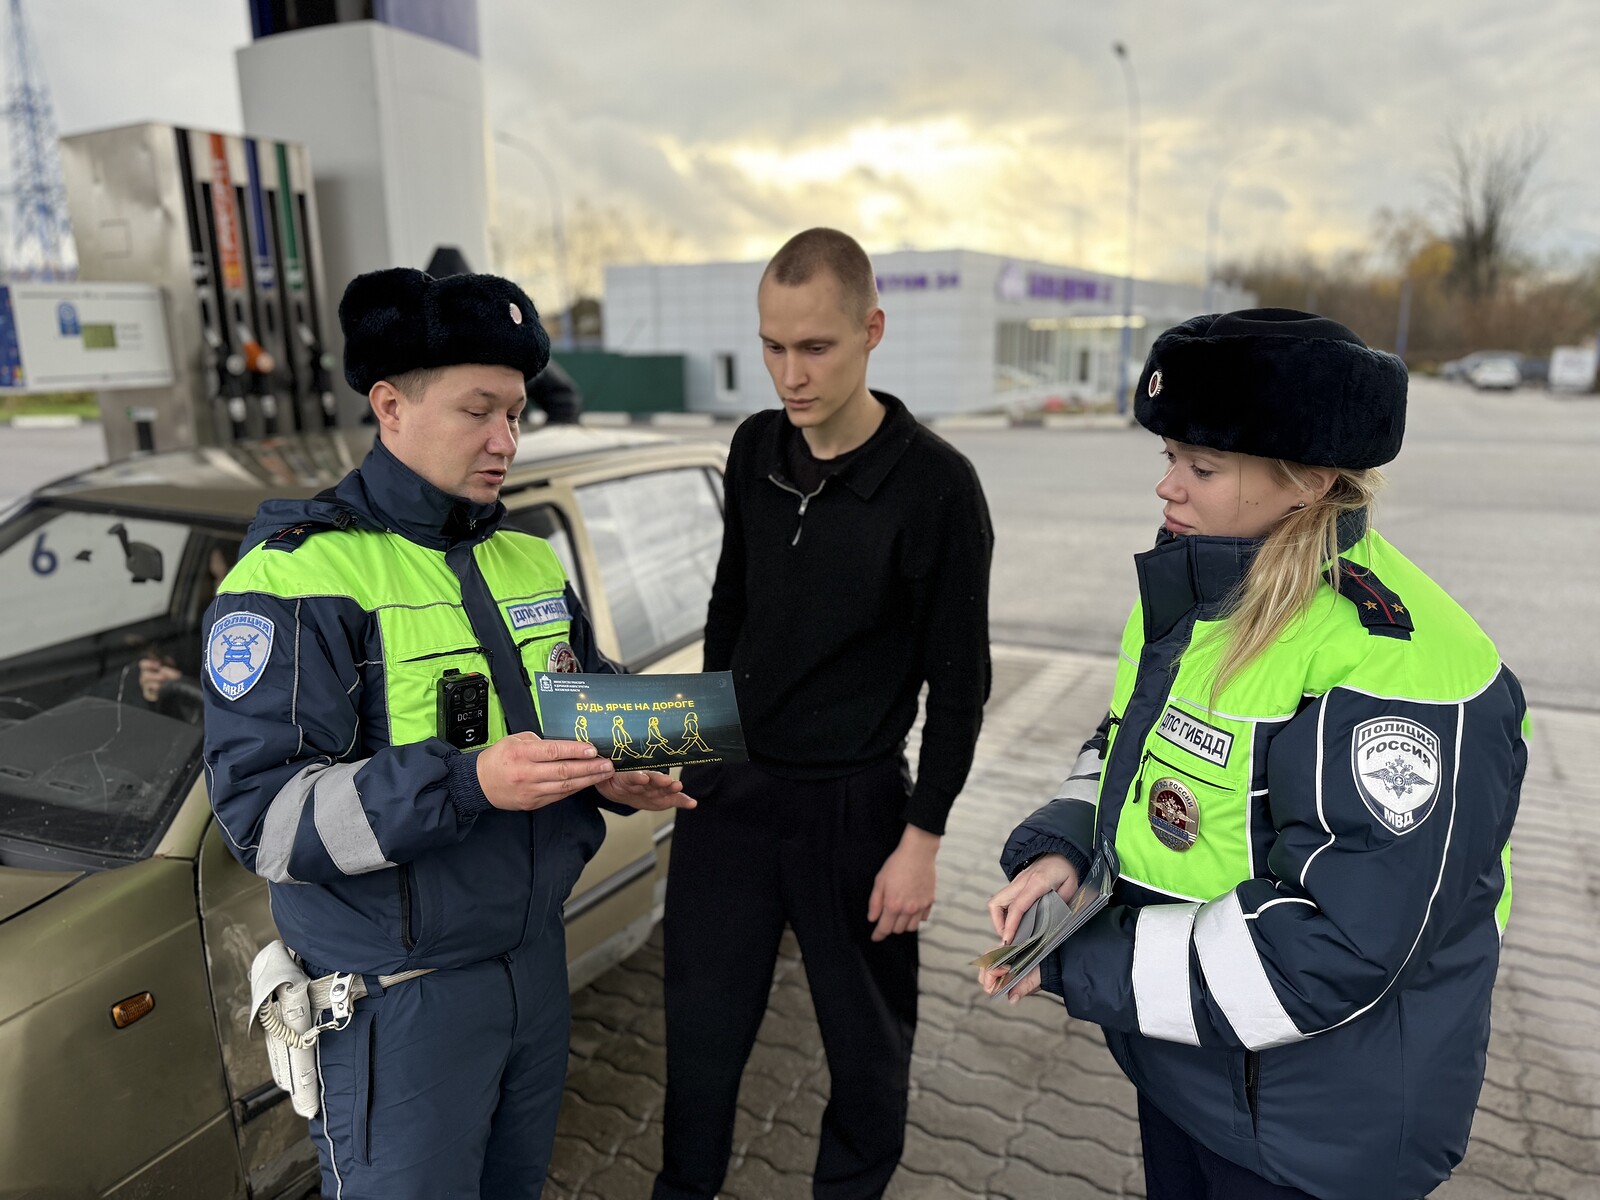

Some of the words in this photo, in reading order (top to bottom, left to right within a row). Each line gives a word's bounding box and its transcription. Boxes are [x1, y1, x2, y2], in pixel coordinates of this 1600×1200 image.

[31, 532, 58, 576] 6
[216, 616, 271, 633] ПОЛИЦИЯ
[513, 608, 536, 623] ДПС
[222, 682, 245, 696] МВД
[576, 702, 604, 713] БУДЬ
[605, 702, 632, 712] ЯРЧЕ
[634, 702, 650, 711] НА
[652, 700, 695, 712] ДОРОГЕ
[1161, 713, 1181, 731] ДПС
[1179, 722, 1226, 759] ГИБДД
[1361, 723, 1435, 752] ПОЛИЦИЯ
[1366, 740, 1431, 769] РОССИЯ
[1383, 807, 1414, 829] МВД
